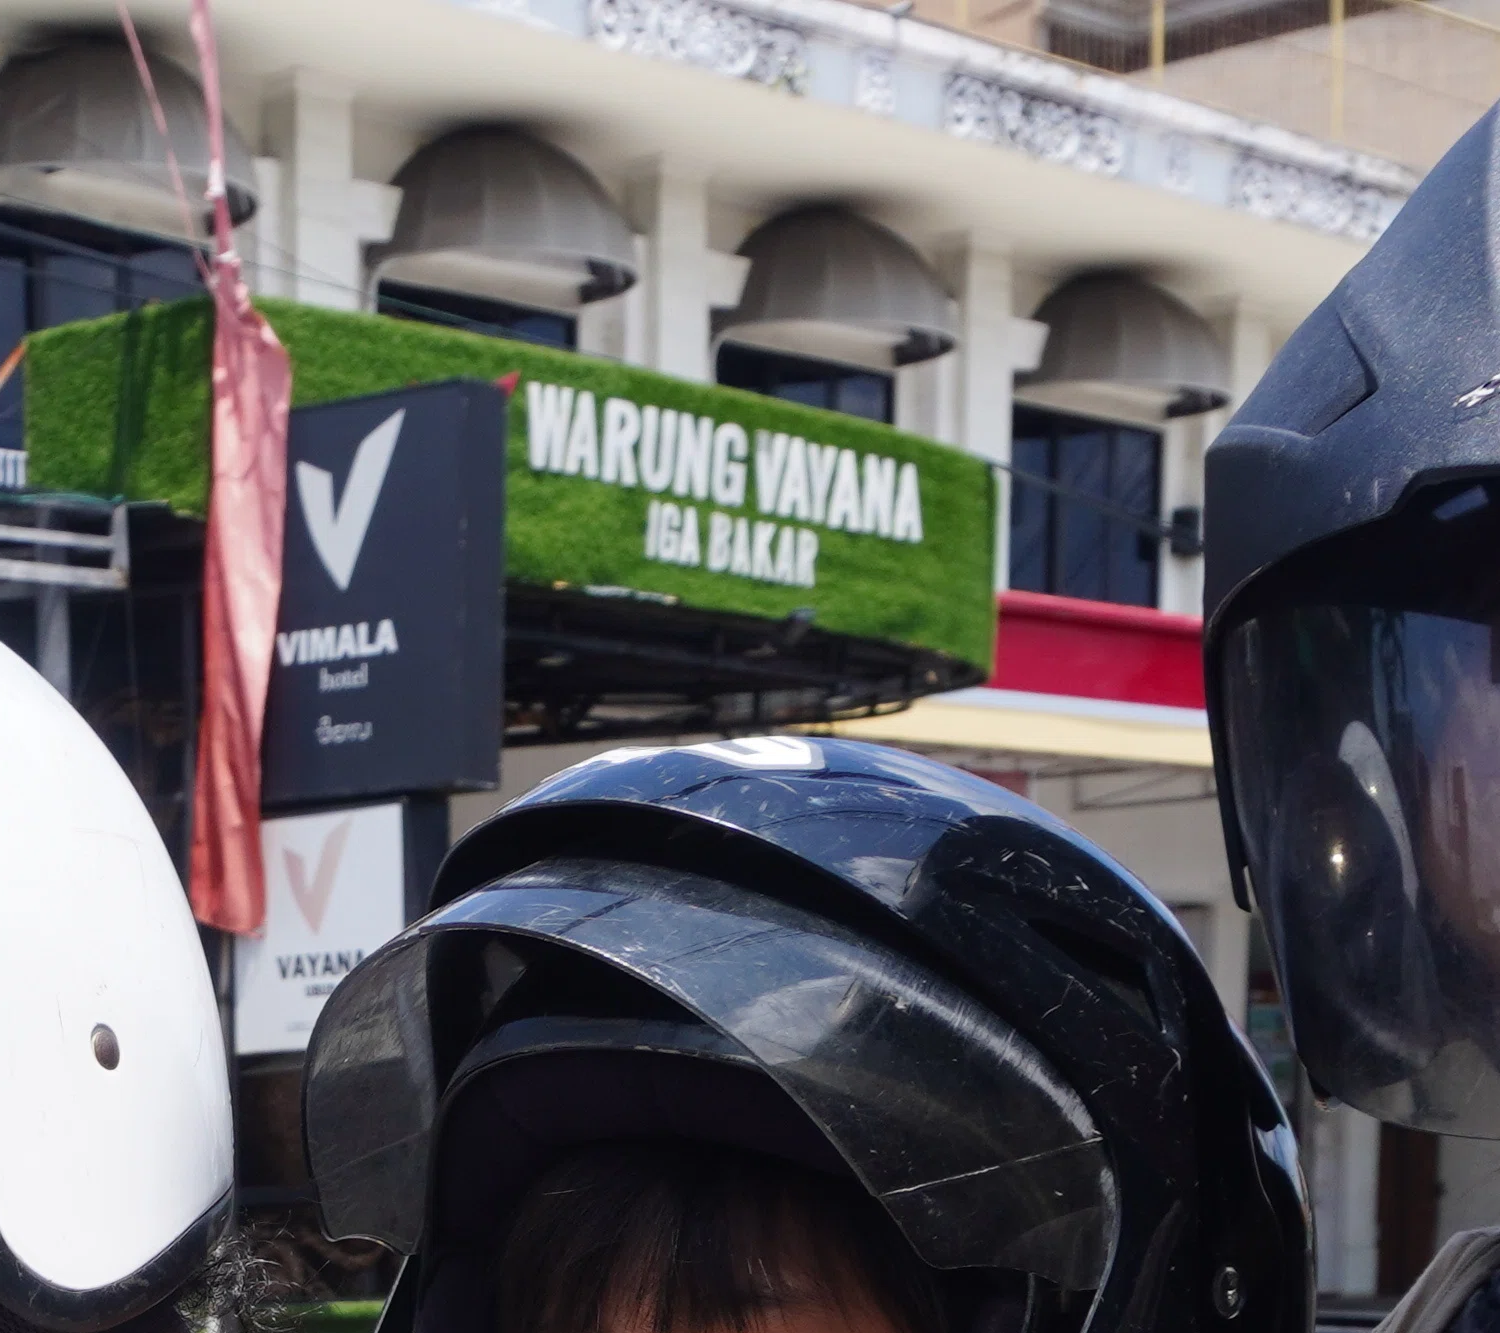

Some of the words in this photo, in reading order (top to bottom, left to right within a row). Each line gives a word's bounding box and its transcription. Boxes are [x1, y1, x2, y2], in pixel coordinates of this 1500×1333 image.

[526, 381, 749, 506] WARUNG
[754, 429, 923, 543] VAYANA
[645, 499, 699, 566] IGA
[707, 511, 820, 588] BAKAR
[276, 618, 399, 666] VIMALA
[319, 662, 369, 693] hotel
